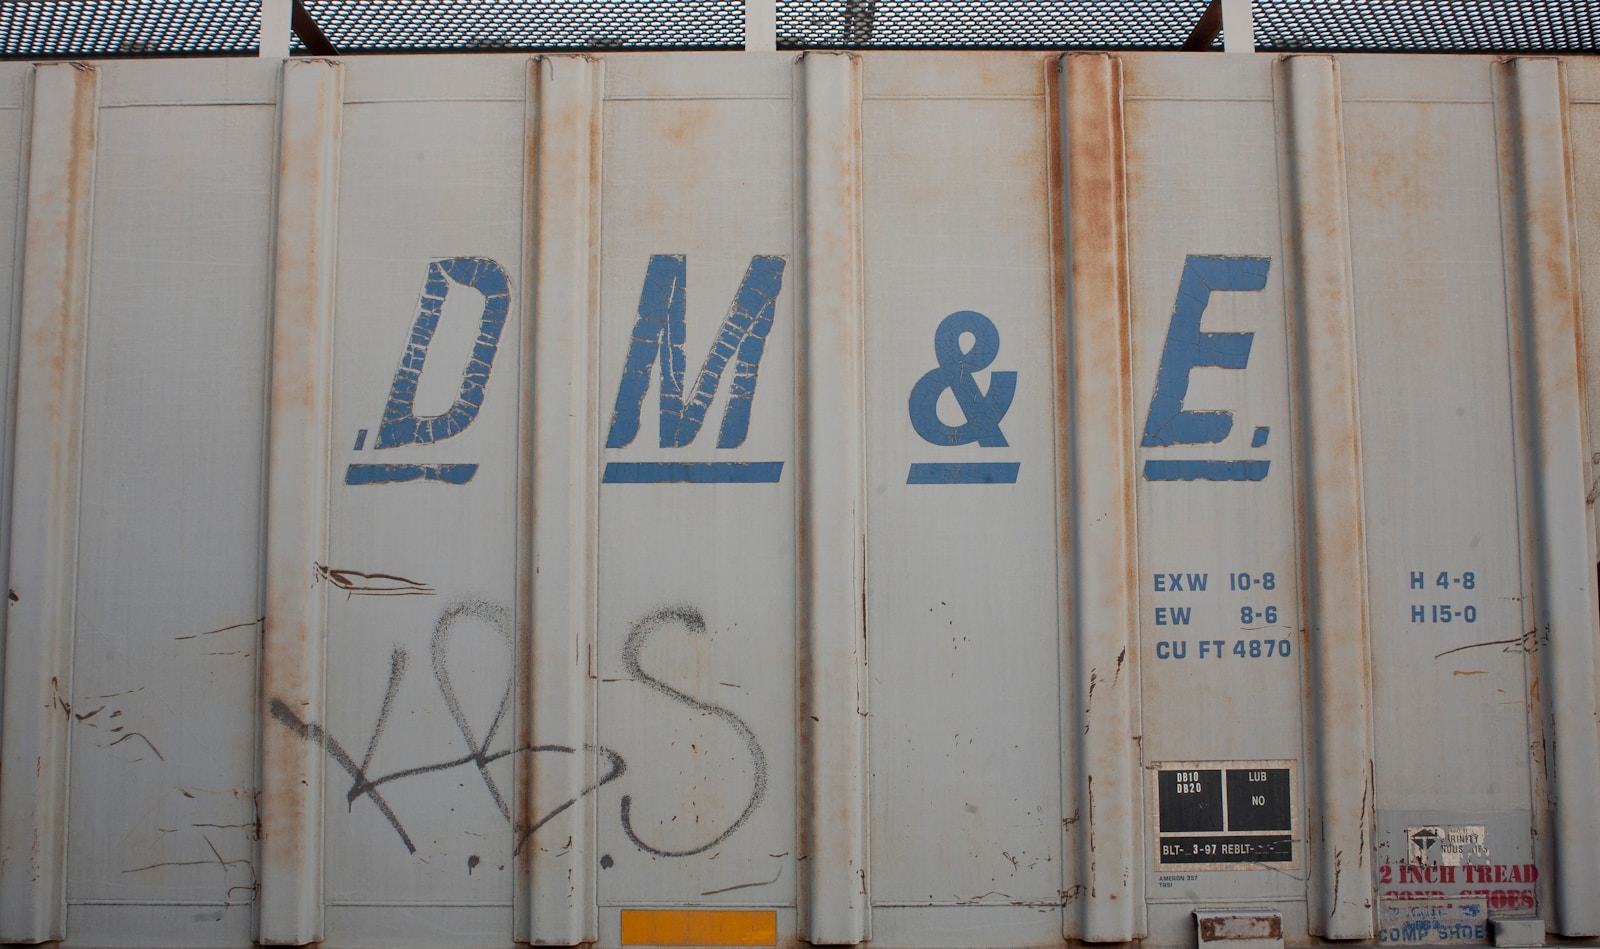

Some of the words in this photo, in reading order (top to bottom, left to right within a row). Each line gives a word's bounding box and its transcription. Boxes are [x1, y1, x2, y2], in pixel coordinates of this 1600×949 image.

[1153, 573, 1209, 592] EXW
[1230, 572, 1276, 591] 10-8
[1411, 571, 1425, 590] H
[1436, 571, 1477, 590] 4-8
[1155, 607, 1193, 626] EW
[1240, 605, 1279, 625] 8-6
[1156, 641, 1188, 660] CU
[1199, 640, 1226, 659] FT
[1233, 639, 1292, 658] 4870
[1176, 771, 1199, 783] DB10
[1248, 771, 1268, 782] LUB
[1176, 782, 1202, 794] DB20
[1252, 795, 1266, 806] NO
[1379, 864, 1393, 884] 2
[1399, 865, 1456, 884] INCH
[1462, 864, 1539, 884] TREAD
